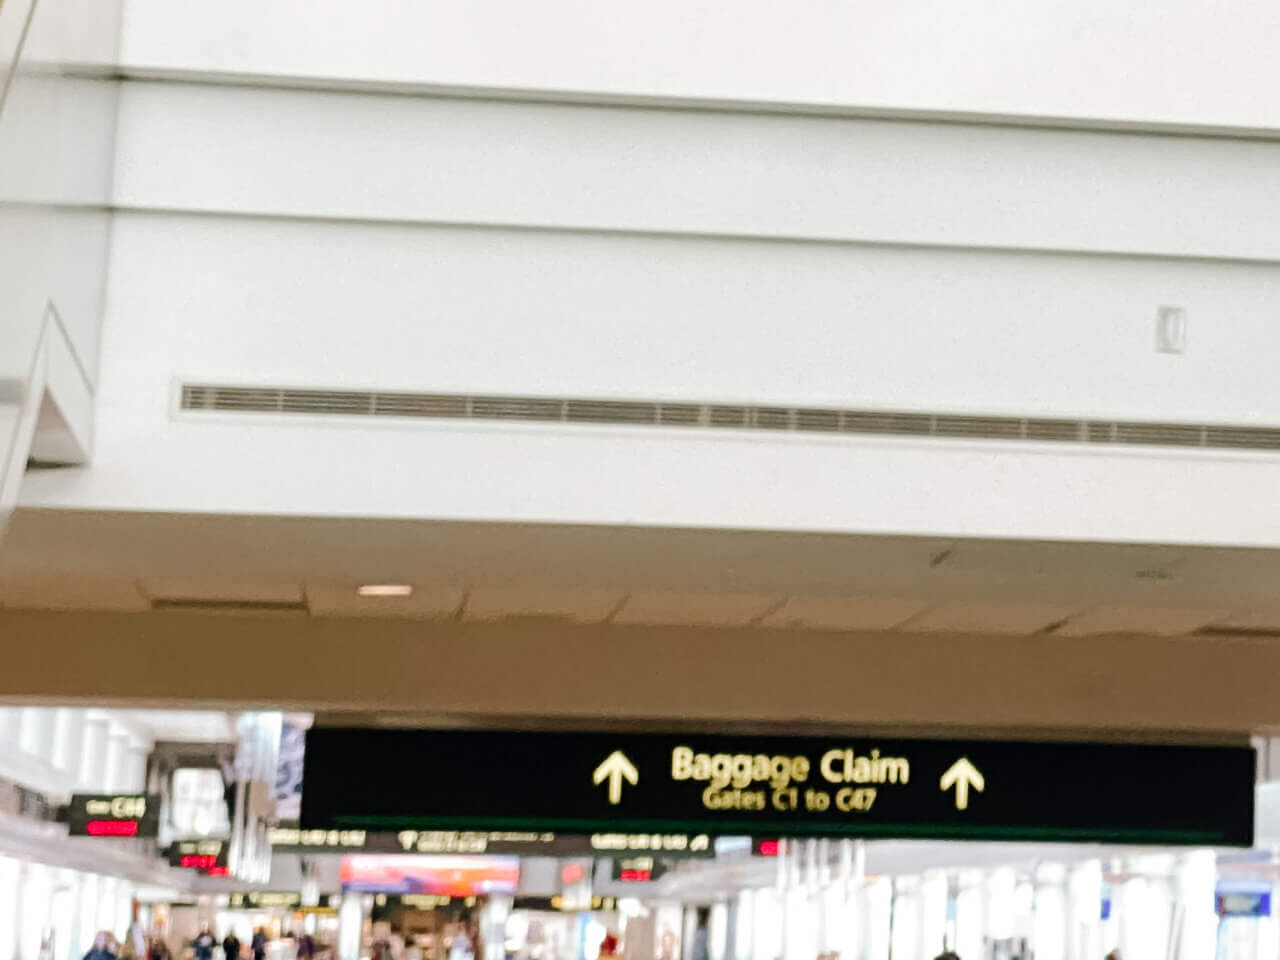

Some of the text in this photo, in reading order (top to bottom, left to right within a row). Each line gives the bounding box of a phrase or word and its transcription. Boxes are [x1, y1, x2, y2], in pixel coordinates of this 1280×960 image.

[671, 746, 910, 790] Baggage Claim
[702, 787, 877, 812] Gates C1 to C47
